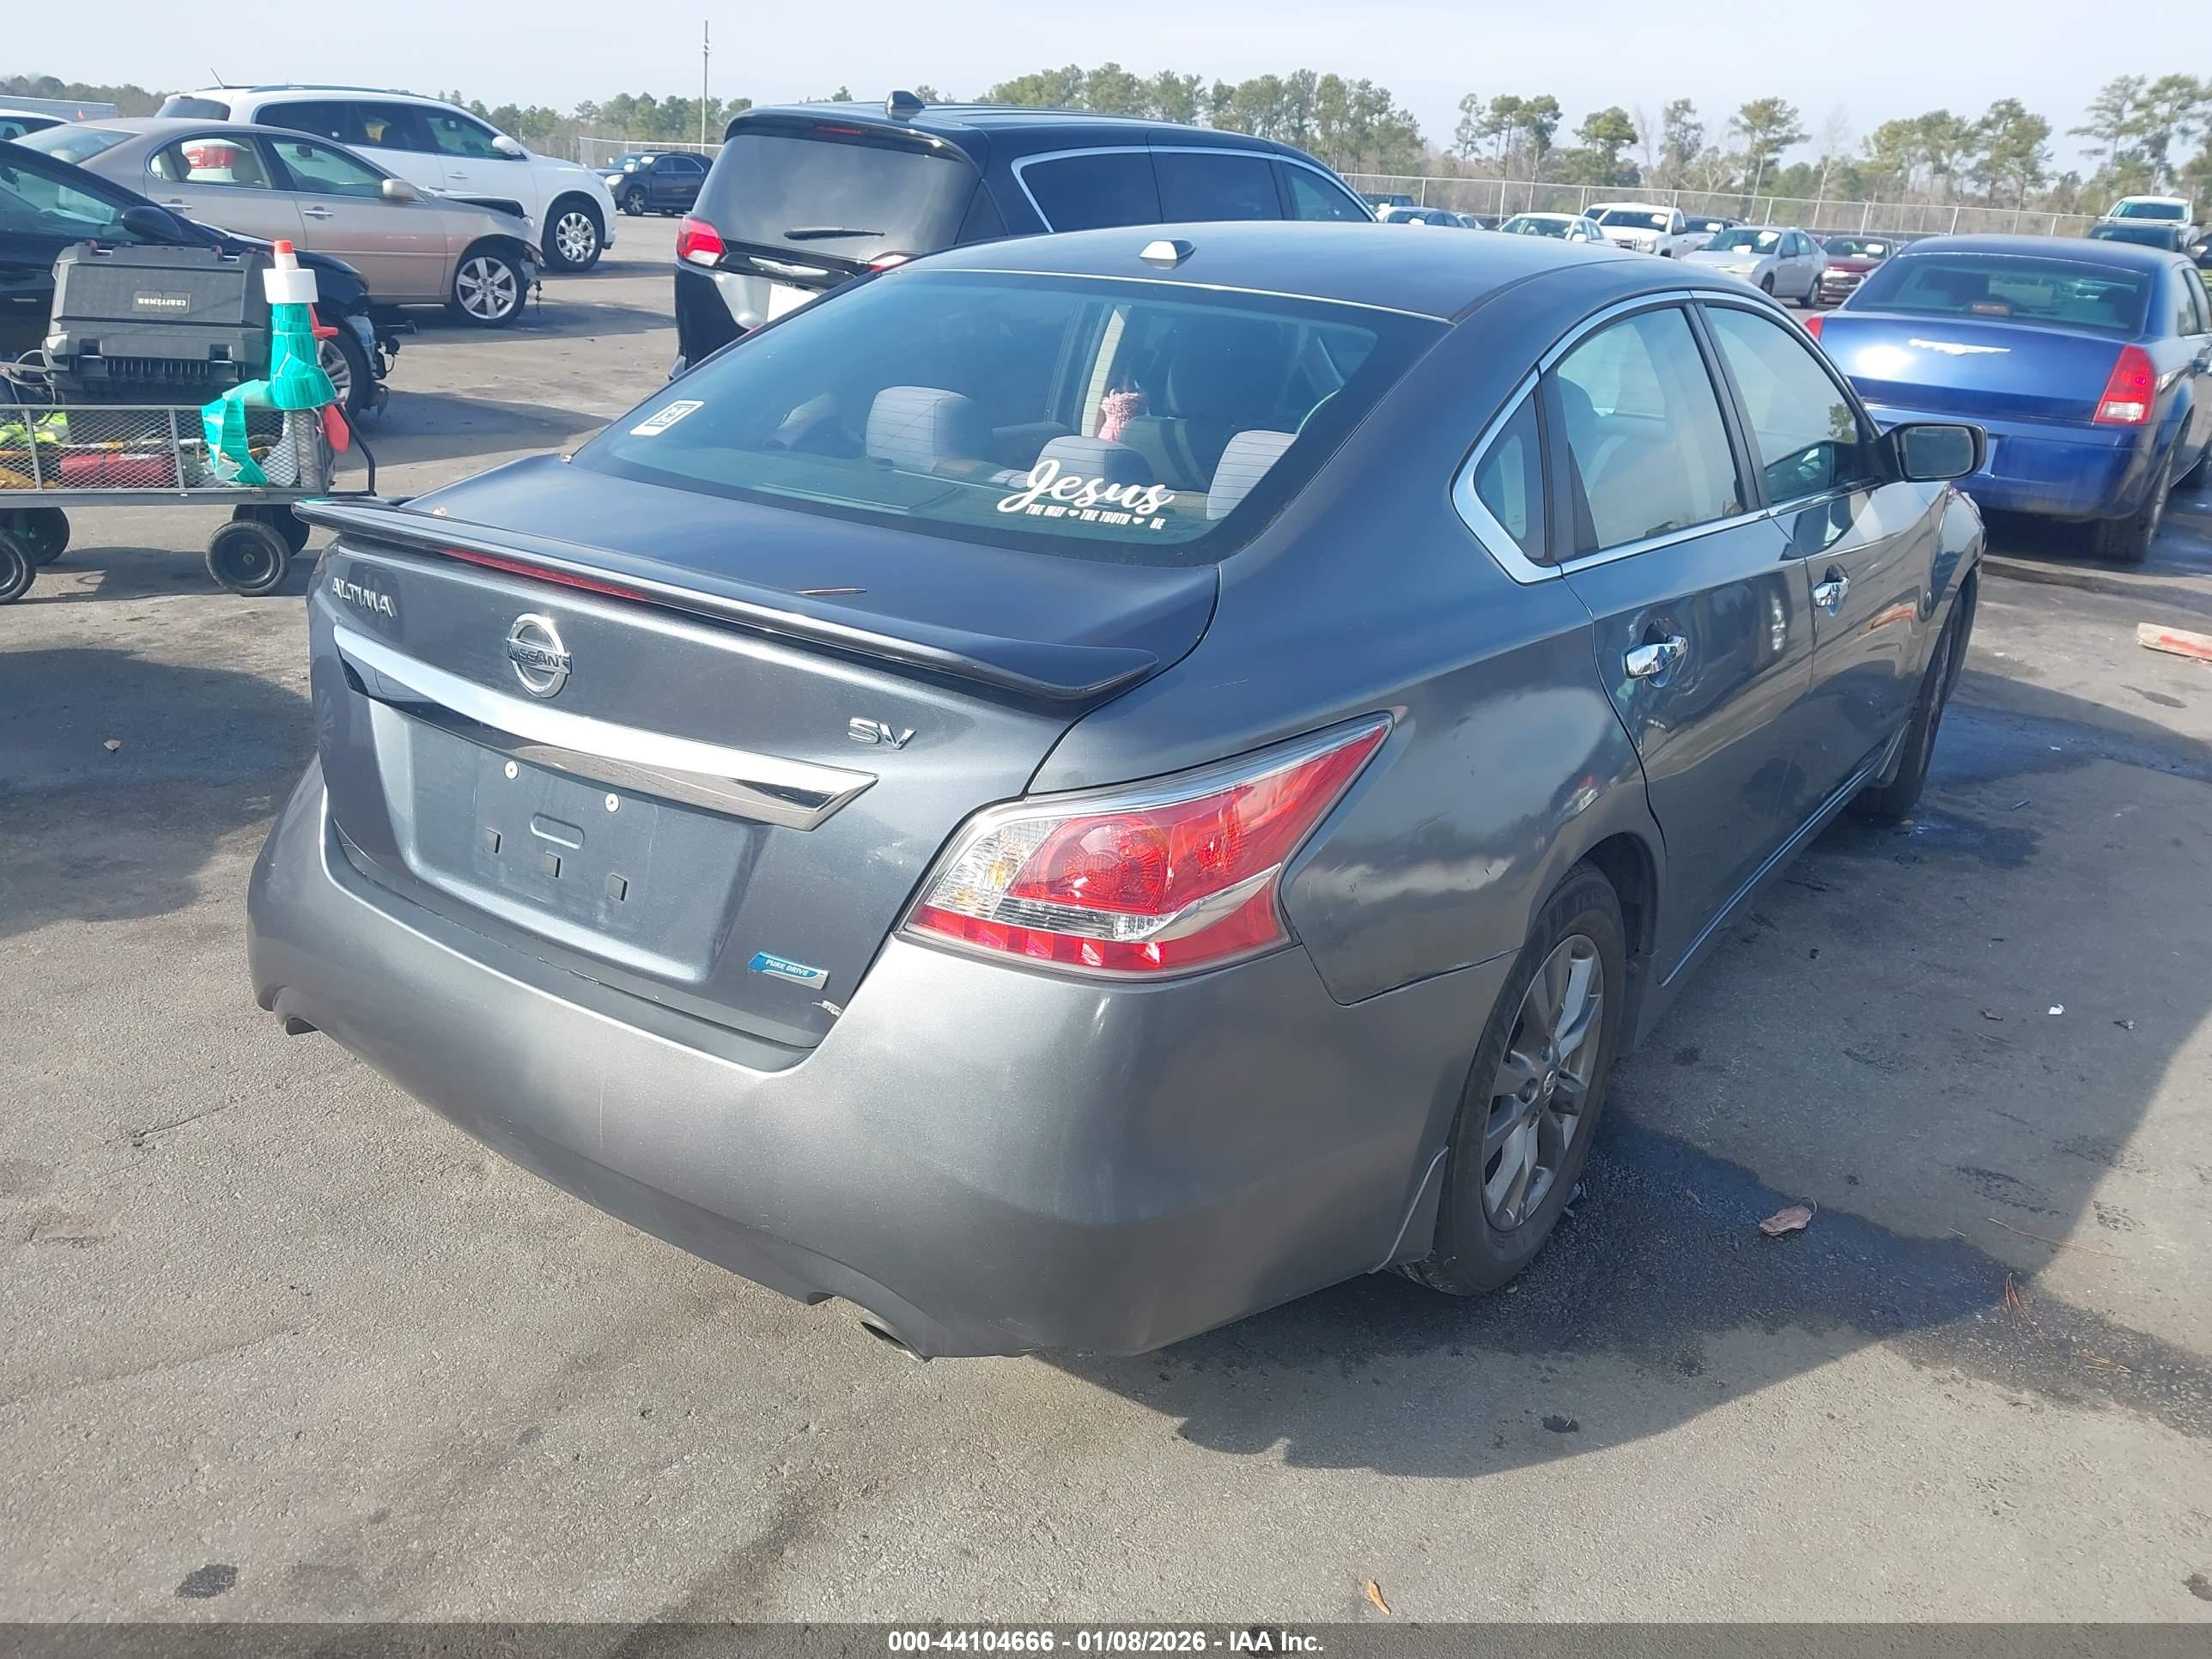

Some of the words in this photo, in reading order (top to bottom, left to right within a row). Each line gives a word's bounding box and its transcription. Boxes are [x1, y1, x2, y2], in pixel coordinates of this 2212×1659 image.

[997, 459, 1176, 514] Jesus
[1025, 503, 1046, 515] THE
[1043, 506, 1068, 518] WAY
[1079, 508, 1100, 521] THE
[1098, 511, 1132, 525] TRUTH
[332, 577, 398, 617] ALTIMA
[507, 645, 561, 667] NISSAN
[848, 717, 916, 750] SV
[765, 959, 786, 969] PURE
[786, 965, 810, 976] DRIVE
